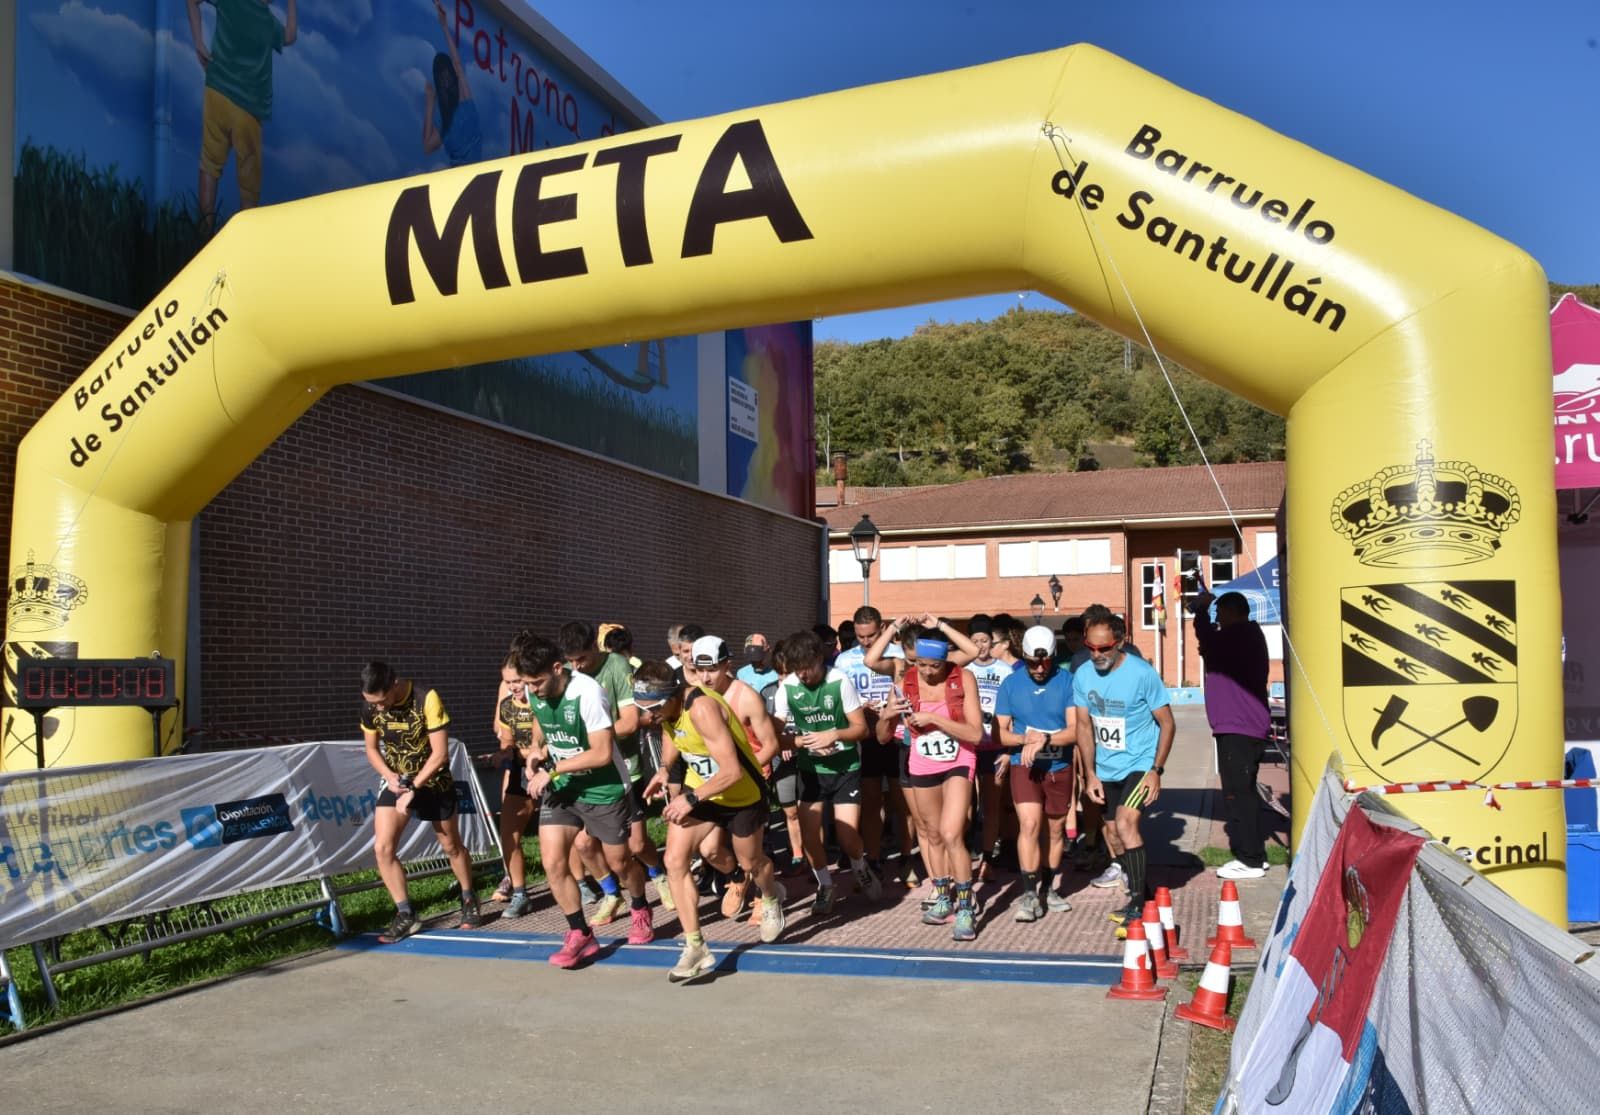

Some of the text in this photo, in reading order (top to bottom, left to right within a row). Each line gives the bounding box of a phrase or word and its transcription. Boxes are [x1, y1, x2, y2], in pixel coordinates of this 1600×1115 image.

[385, 119, 814, 305] META
[1125, 124, 1335, 245] Barruelo
[1051, 161, 1347, 332] de Santullán
[70, 307, 229, 467] de Santullán
[74, 300, 179, 411] Barruelo
[852, 673, 869, 690] 10
[921, 739, 956, 756] 113
